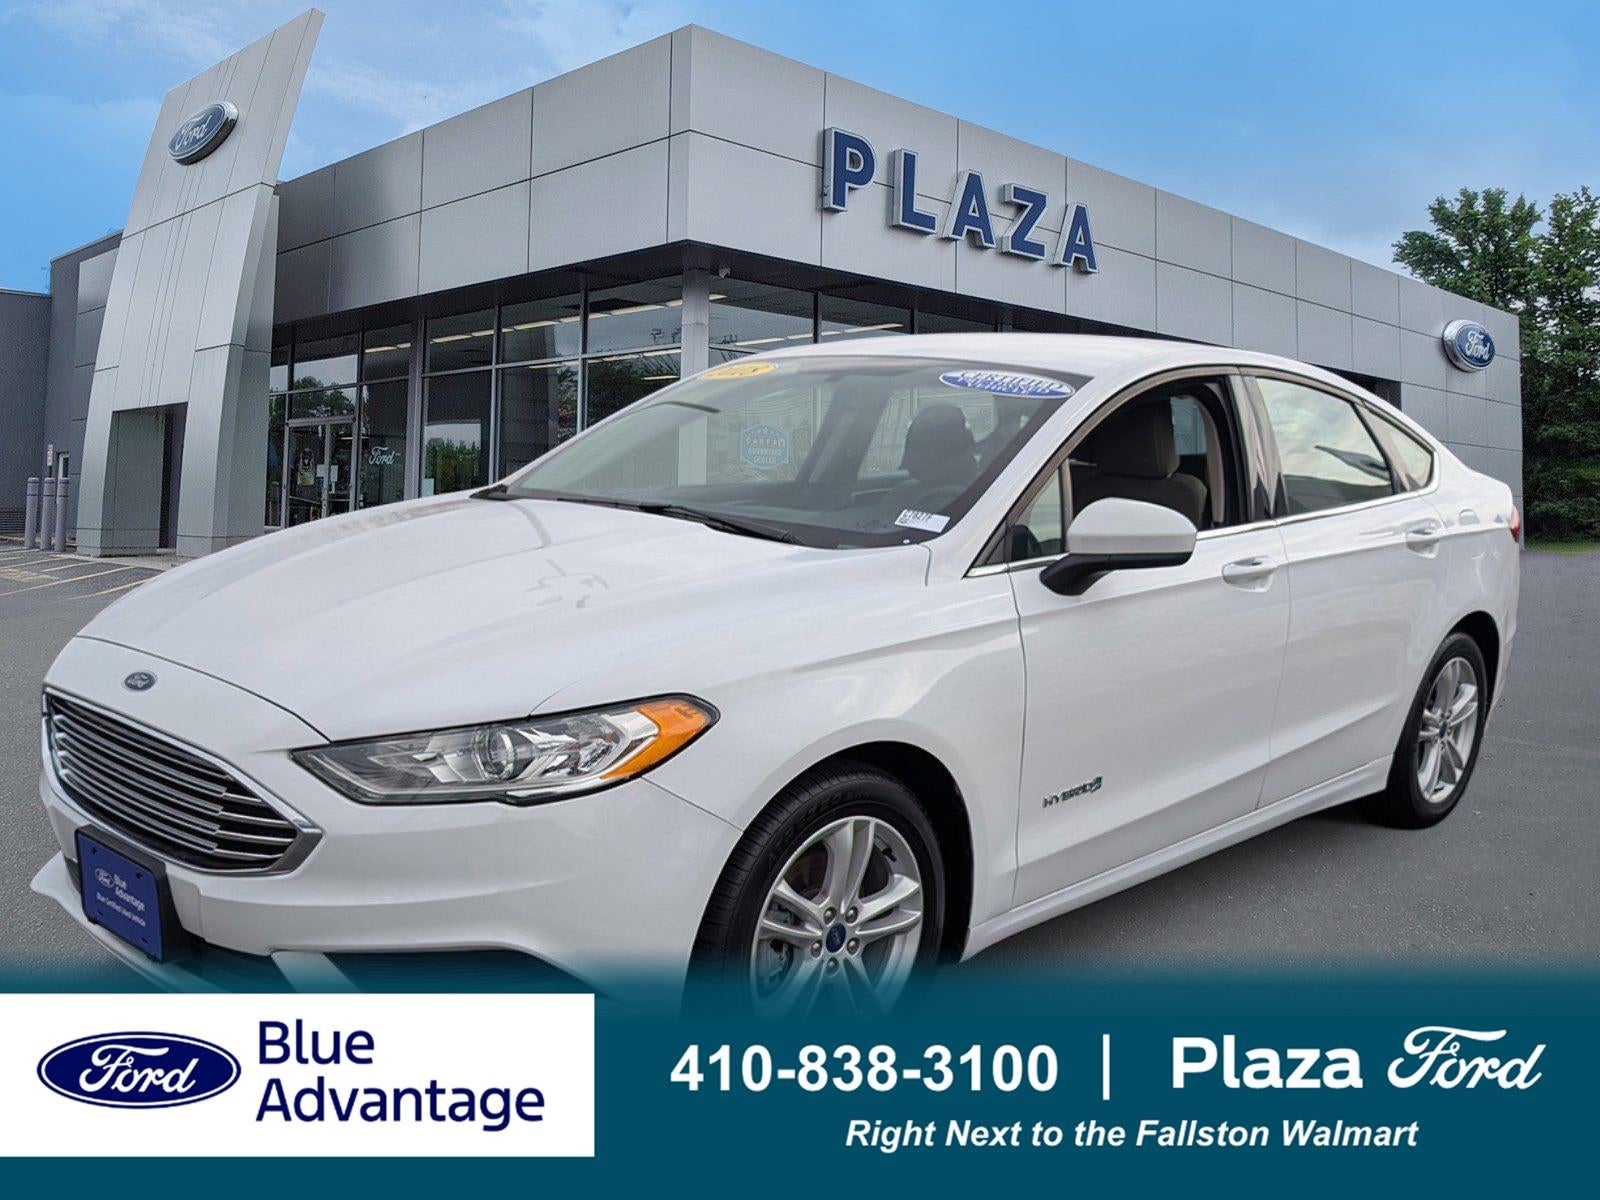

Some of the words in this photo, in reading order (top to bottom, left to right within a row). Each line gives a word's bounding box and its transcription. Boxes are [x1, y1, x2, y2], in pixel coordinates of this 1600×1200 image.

[173, 113, 213, 151] Ford
[823, 127, 1098, 273] PLAZA
[1465, 331, 1490, 360] Ford
[369, 446, 395, 465] Ford
[1042, 782, 1094, 809] HYBRID
